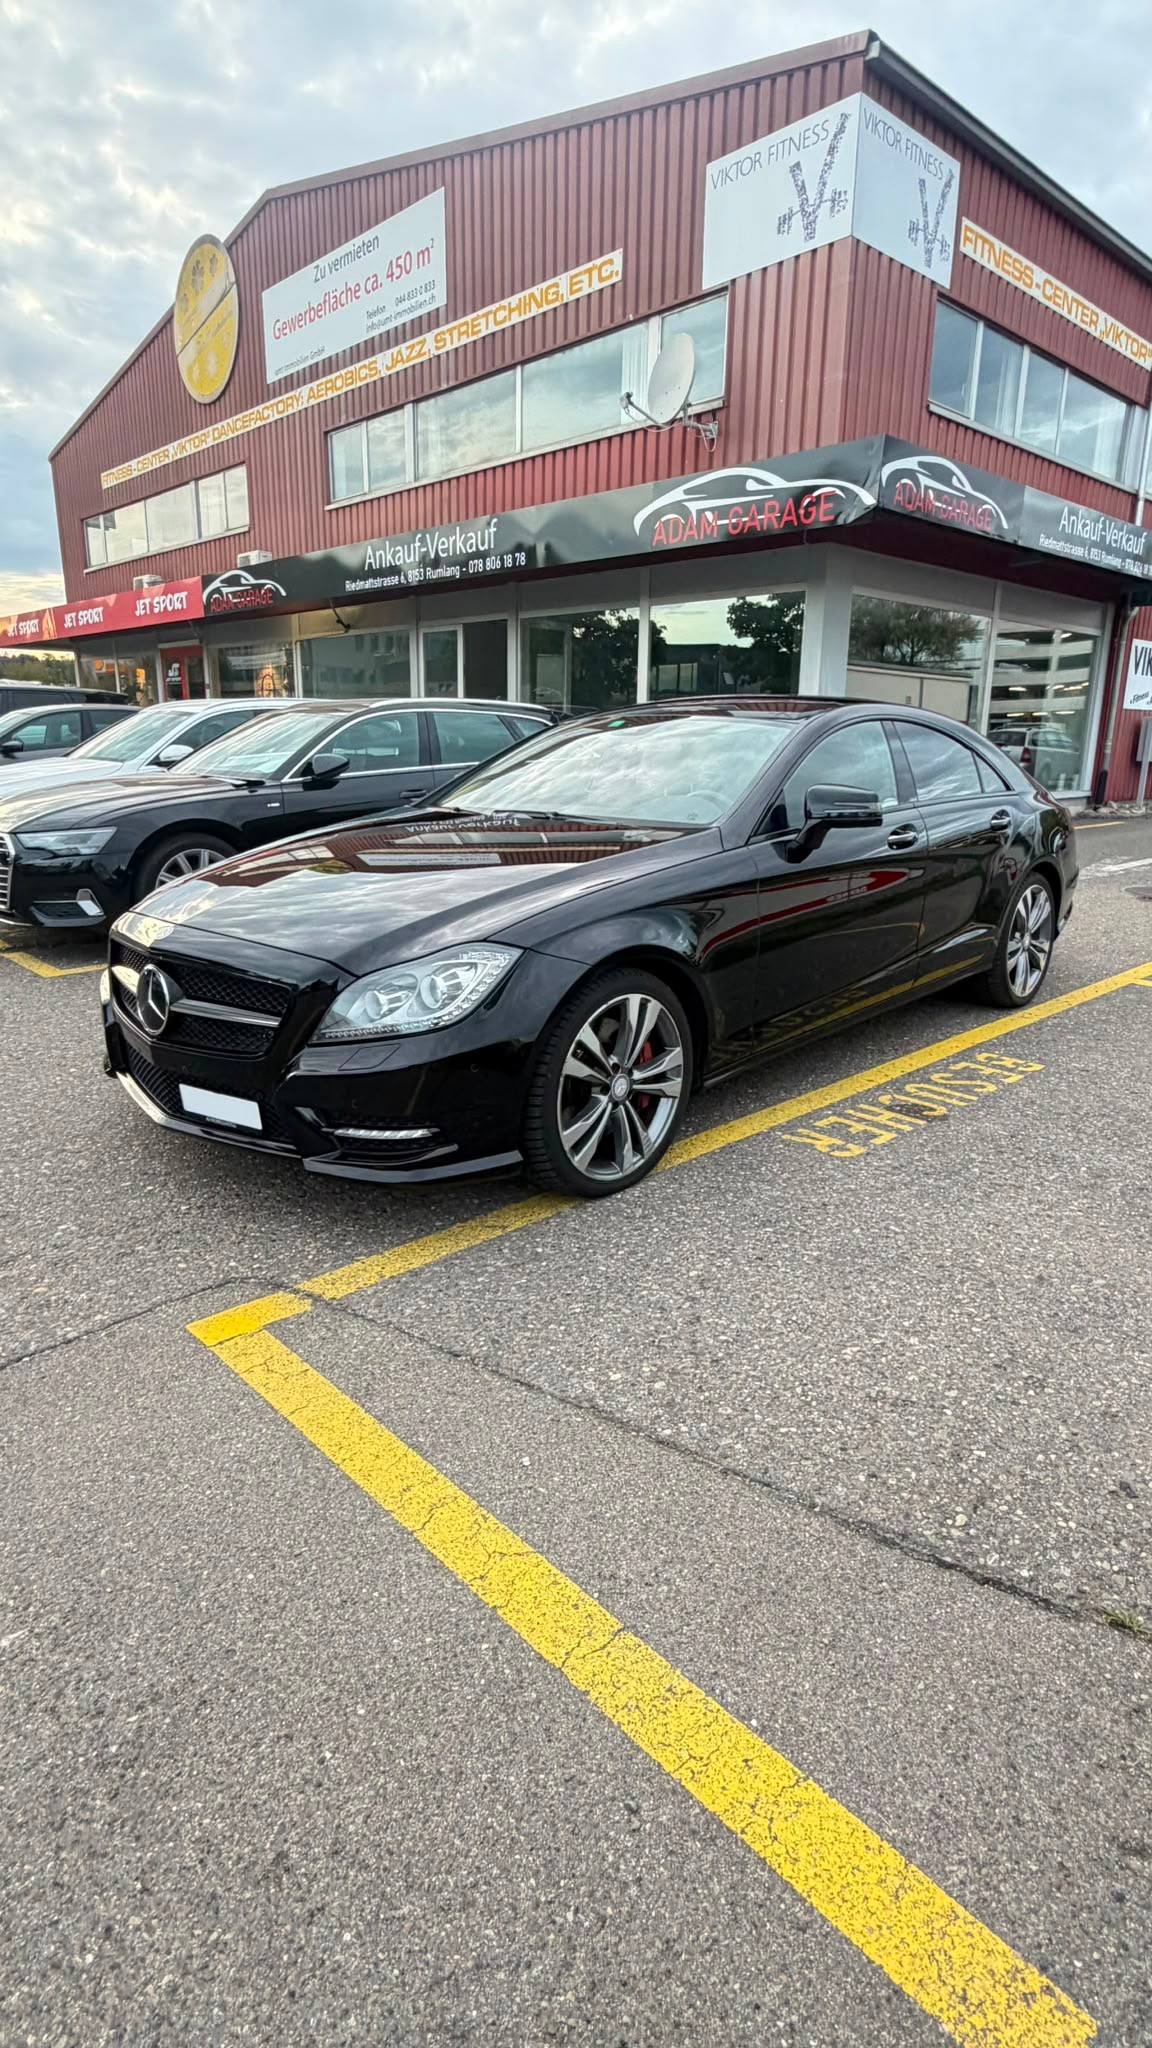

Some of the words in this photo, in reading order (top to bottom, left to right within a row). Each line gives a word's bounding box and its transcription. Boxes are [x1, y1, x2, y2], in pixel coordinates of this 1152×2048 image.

[711, 151, 762, 189] VIKTOR
[768, 120, 829, 165] FITNESS
[864, 108, 901, 153] VIKTOR
[905, 138, 944, 180] FITNESS
[313, 264, 326, 283] Zu
[328, 235, 379, 275] vermieten
[273, 282, 361, 340] Gewerbefläche
[364, 272, 383, 295] ca.
[386, 251, 412, 282] 450
[366, 305, 385, 320] Telefon
[395, 293, 405, 307] 044
[407, 288, 418, 301] 833
[424, 279, 435, 293] 833
[434, 282, 564, 351] STRETCHING,
[569, 258, 619, 296] ETC.
[652, 510, 718, 547] ADAM
[728, 489, 837, 536] GARAGE
[893, 481, 936, 517] ADAM
[940, 494, 992, 531] GARAGE
[1059, 506, 1147, 555] Ankauf-Verkauf
[365, 518, 498, 571] Ankauf-Verkauf
[345, 576, 399, 592] Riedmattstrasse
[408, 568, 424, 582] 8153
[426, 565, 460, 578] Rumlang
[468, 558, 483, 573] 078
[485, 555, 501, 570] 806
[503, 554, 513, 568] 18
[515, 552, 526, 566] 78
[64, 612, 77, 628] JET
[78, 606, 103, 626] SPORT
[135, 598, 151, 617] JET
[153, 591, 188, 614] SPORT
[237, 588, 273, 608] GARAGE
[19, 618, 40, 636] SPORT
[782, 1052, 1045, 1158] BESUCHER
